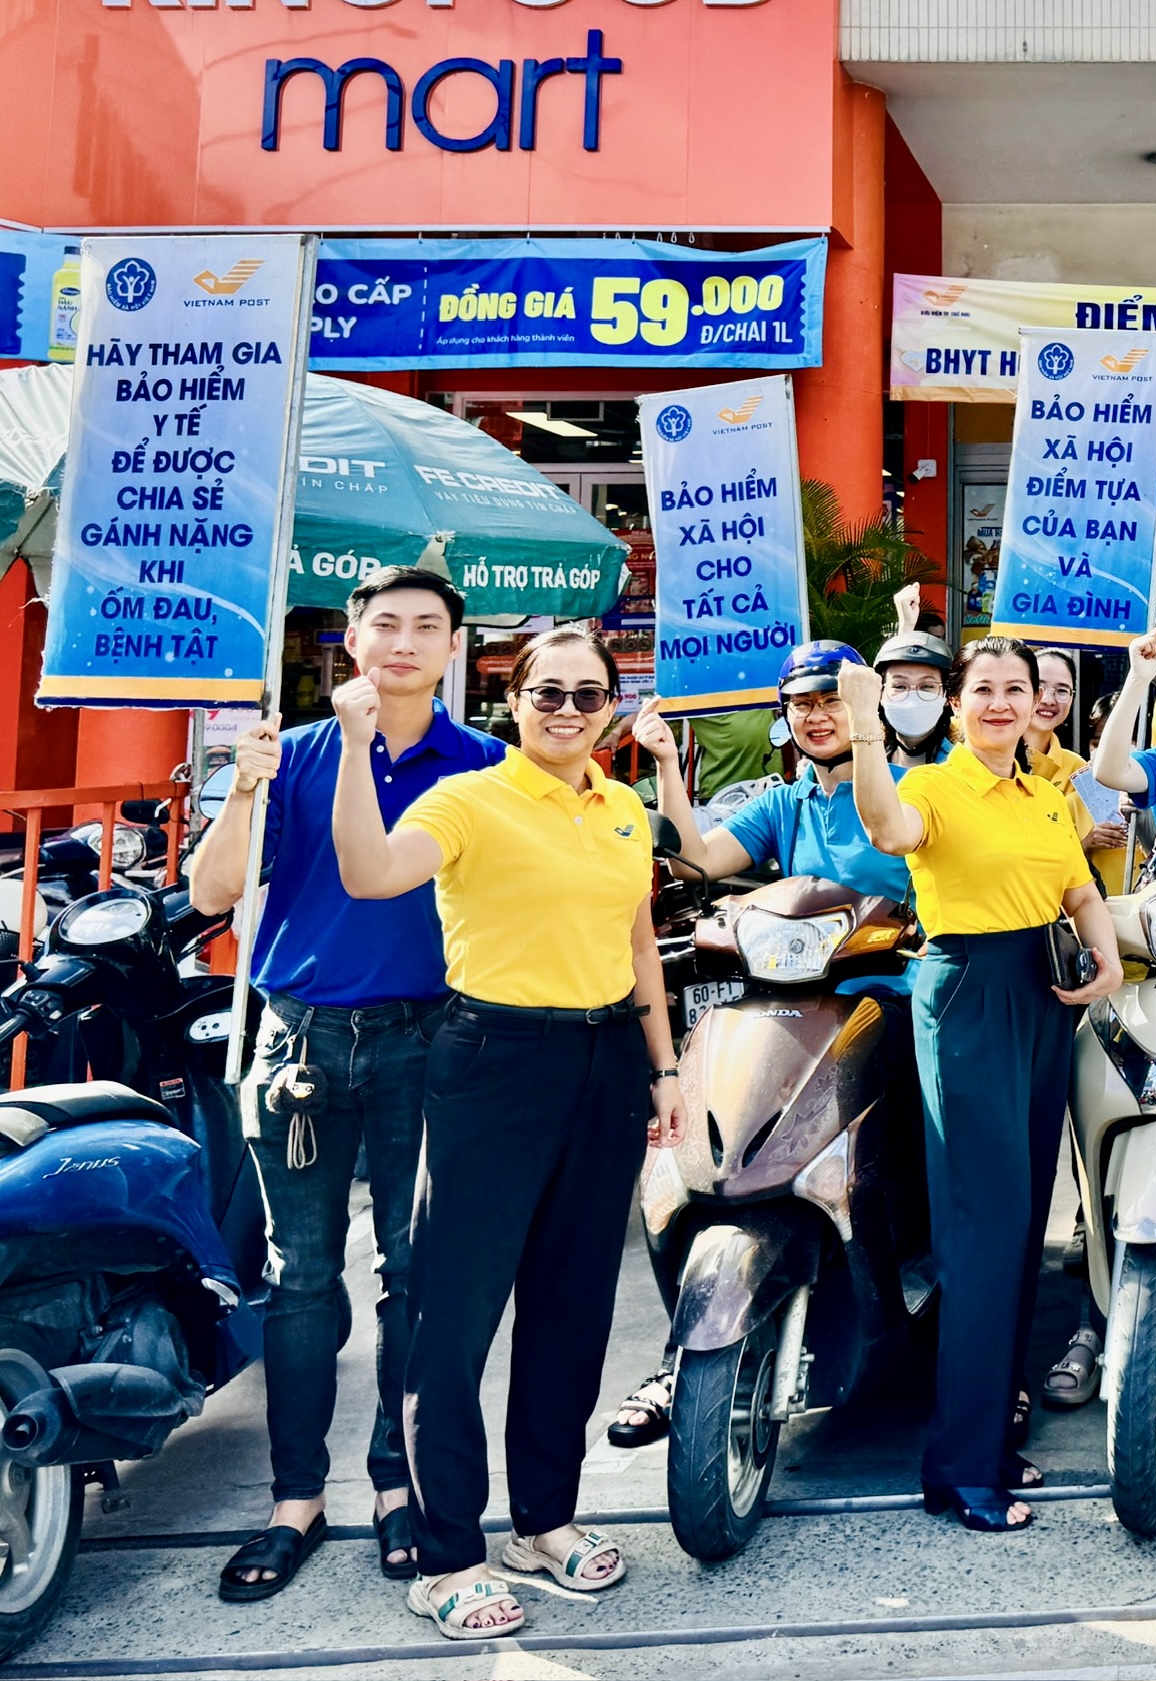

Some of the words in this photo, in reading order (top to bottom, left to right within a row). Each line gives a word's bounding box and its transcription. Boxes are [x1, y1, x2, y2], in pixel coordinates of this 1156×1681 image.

[261, 28, 623, 153] mart
[183, 299, 235, 308] VIETNAM
[239, 298, 271, 307] POST
[347, 276, 412, 305] CẤP
[438, 283, 517, 323] ĐỒNG
[524, 287, 576, 320] GIÁ
[471, 336, 486, 344] cho
[532, 333, 555, 342] thành
[701, 321, 767, 345] Đ/CHAI
[772, 322, 793, 344] 1L
[86, 338, 143, 366] HÃY
[149, 341, 224, 366] THAM
[232, 341, 282, 365] GIA
[925, 348, 992, 376] BHYT
[115, 371, 173, 402] BẢO
[179, 365, 245, 401] HIỂM
[1092, 374, 1129, 382] VIETNAM
[1131, 375, 1154, 383] POST
[153, 414, 168, 436] Y
[174, 403, 208, 436] TẾ
[1031, 394, 1085, 423] BẢO
[1093, 393, 1153, 425] HIỂM
[712, 425, 749, 436] VIETNAM
[751, 422, 773, 431] POST
[111, 437, 150, 474] ĐỂ
[152, 446, 236, 480] ĐƯỢC
[1042, 435, 1078, 460] XÃ
[1087, 436, 1133, 468] HỘI
[116, 486, 184, 511] CHIA
[191, 478, 224, 511] SẺ
[413, 465, 461, 488] FE
[456, 471, 562, 500] CREDIT
[660, 480, 714, 512] BẢO
[721, 468, 778, 504] HIỂM
[1026, 467, 1086, 499] ĐIỂM
[1096, 477, 1142, 507] TỰA
[80, 516, 162, 547] GÁNH
[168, 517, 254, 554] NẶNG
[678, 518, 716, 547] XÃ
[721, 512, 766, 545] HỘI
[1022, 509, 1077, 539] CỦA
[1086, 519, 1138, 546] BẠN
[139, 560, 184, 584] KHI
[312, 549, 381, 581] GÓP
[463, 556, 488, 588] HỖ
[492, 565, 529, 592] TRỢ
[531, 562, 568, 588] TRẢ
[569, 563, 601, 590] GÓP
[696, 556, 752, 581] CHO
[1058, 551, 1093, 579] VÀ
[100, 586, 145, 620] ỐM
[152, 597, 218, 625] ĐAU,
[682, 588, 726, 620] TẤT
[731, 583, 769, 614] CẢ
[1012, 592, 1058, 616] GIA
[1067, 591, 1131, 620] ĐÌNH
[94, 627, 162, 665] BỆNH
[170, 627, 218, 665] TẬT
[659, 634, 709, 666] MỌI
[715, 620, 797, 656] NGƯỜI
